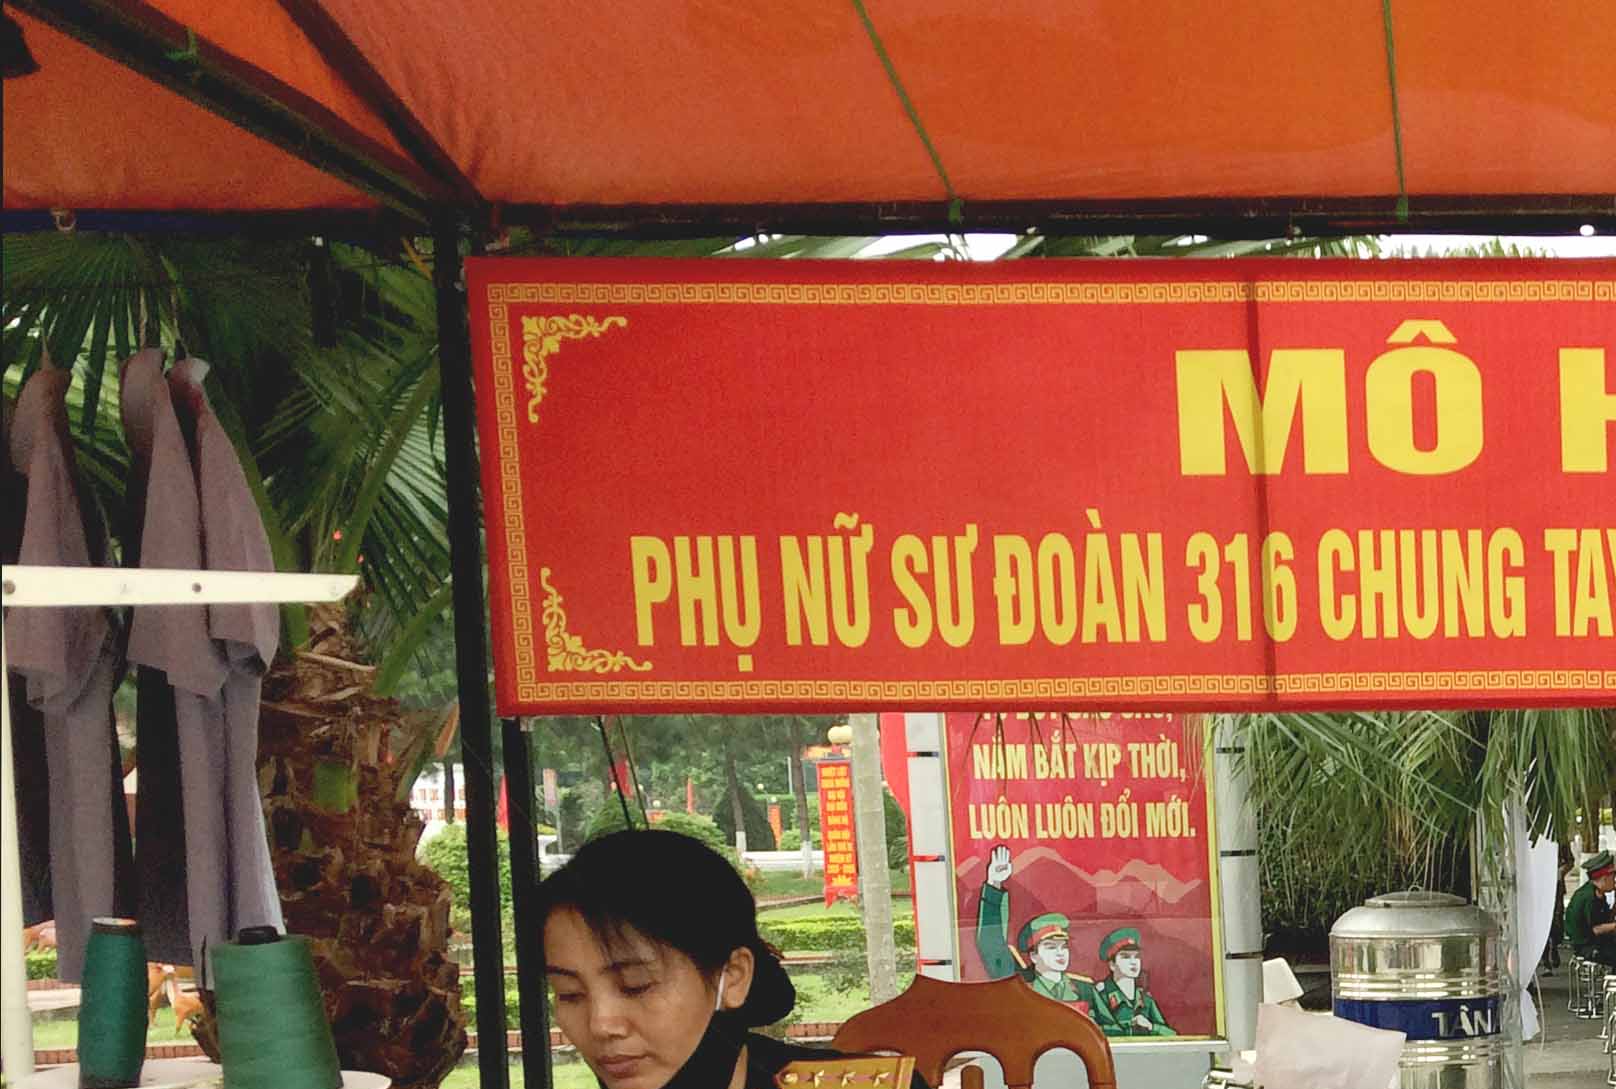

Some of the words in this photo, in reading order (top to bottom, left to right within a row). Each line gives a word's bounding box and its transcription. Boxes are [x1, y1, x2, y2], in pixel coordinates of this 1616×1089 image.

[1175, 319, 1484, 475] MÔ
[630, 534, 760, 672] PHỤ
[780, 512, 874, 648] NỮ
[892, 523, 978, 648] SƯ
[994, 508, 1167, 646] ĐOÀN
[1185, 530, 1297, 642] 316
[1317, 526, 1525, 641] CHUNG
[1033, 730, 1077, 780] BẮT
[1083, 743, 1122, 787] KỊP
[1127, 733, 1187, 782] THỜI,
[968, 796, 1029, 839] LUÔN
[1035, 796, 1095, 839] LUÔN
[1100, 788, 1139, 839] ĐỔI
[1145, 793, 1196, 839] MỚI.
[1431, 1004, 1492, 1038] TÂN
